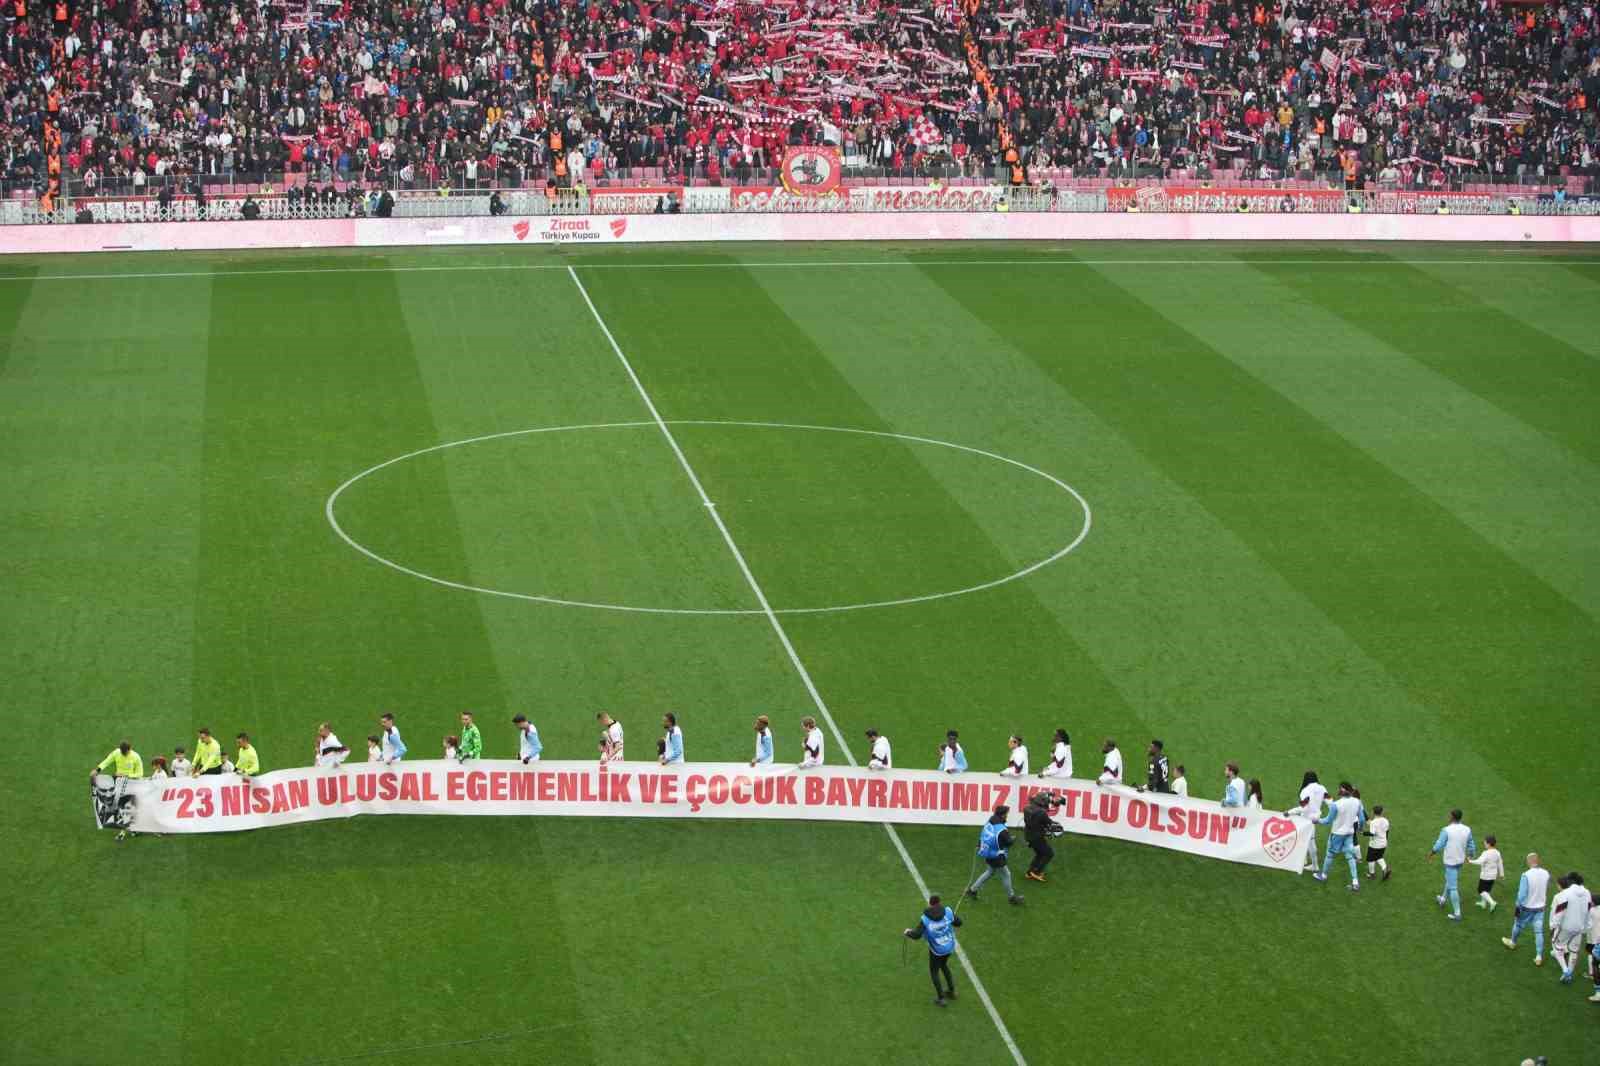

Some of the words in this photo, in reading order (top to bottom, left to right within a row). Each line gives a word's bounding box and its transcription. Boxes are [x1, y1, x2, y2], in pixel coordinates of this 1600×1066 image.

[551, 219, 589, 231] Ziraat
[541, 231, 570, 240] Türkiye
[572, 230, 600, 240] Kupası
[220, 779, 310, 817] NİSAN
[317, 772, 439, 806] ULUSAL
[447, 766, 632, 804] EGEMENLİK
[638, 773, 679, 805] VE
[686, 773, 798, 813] ÇOCUK
[804, 776, 1012, 813] BAYRAMIMIZ
